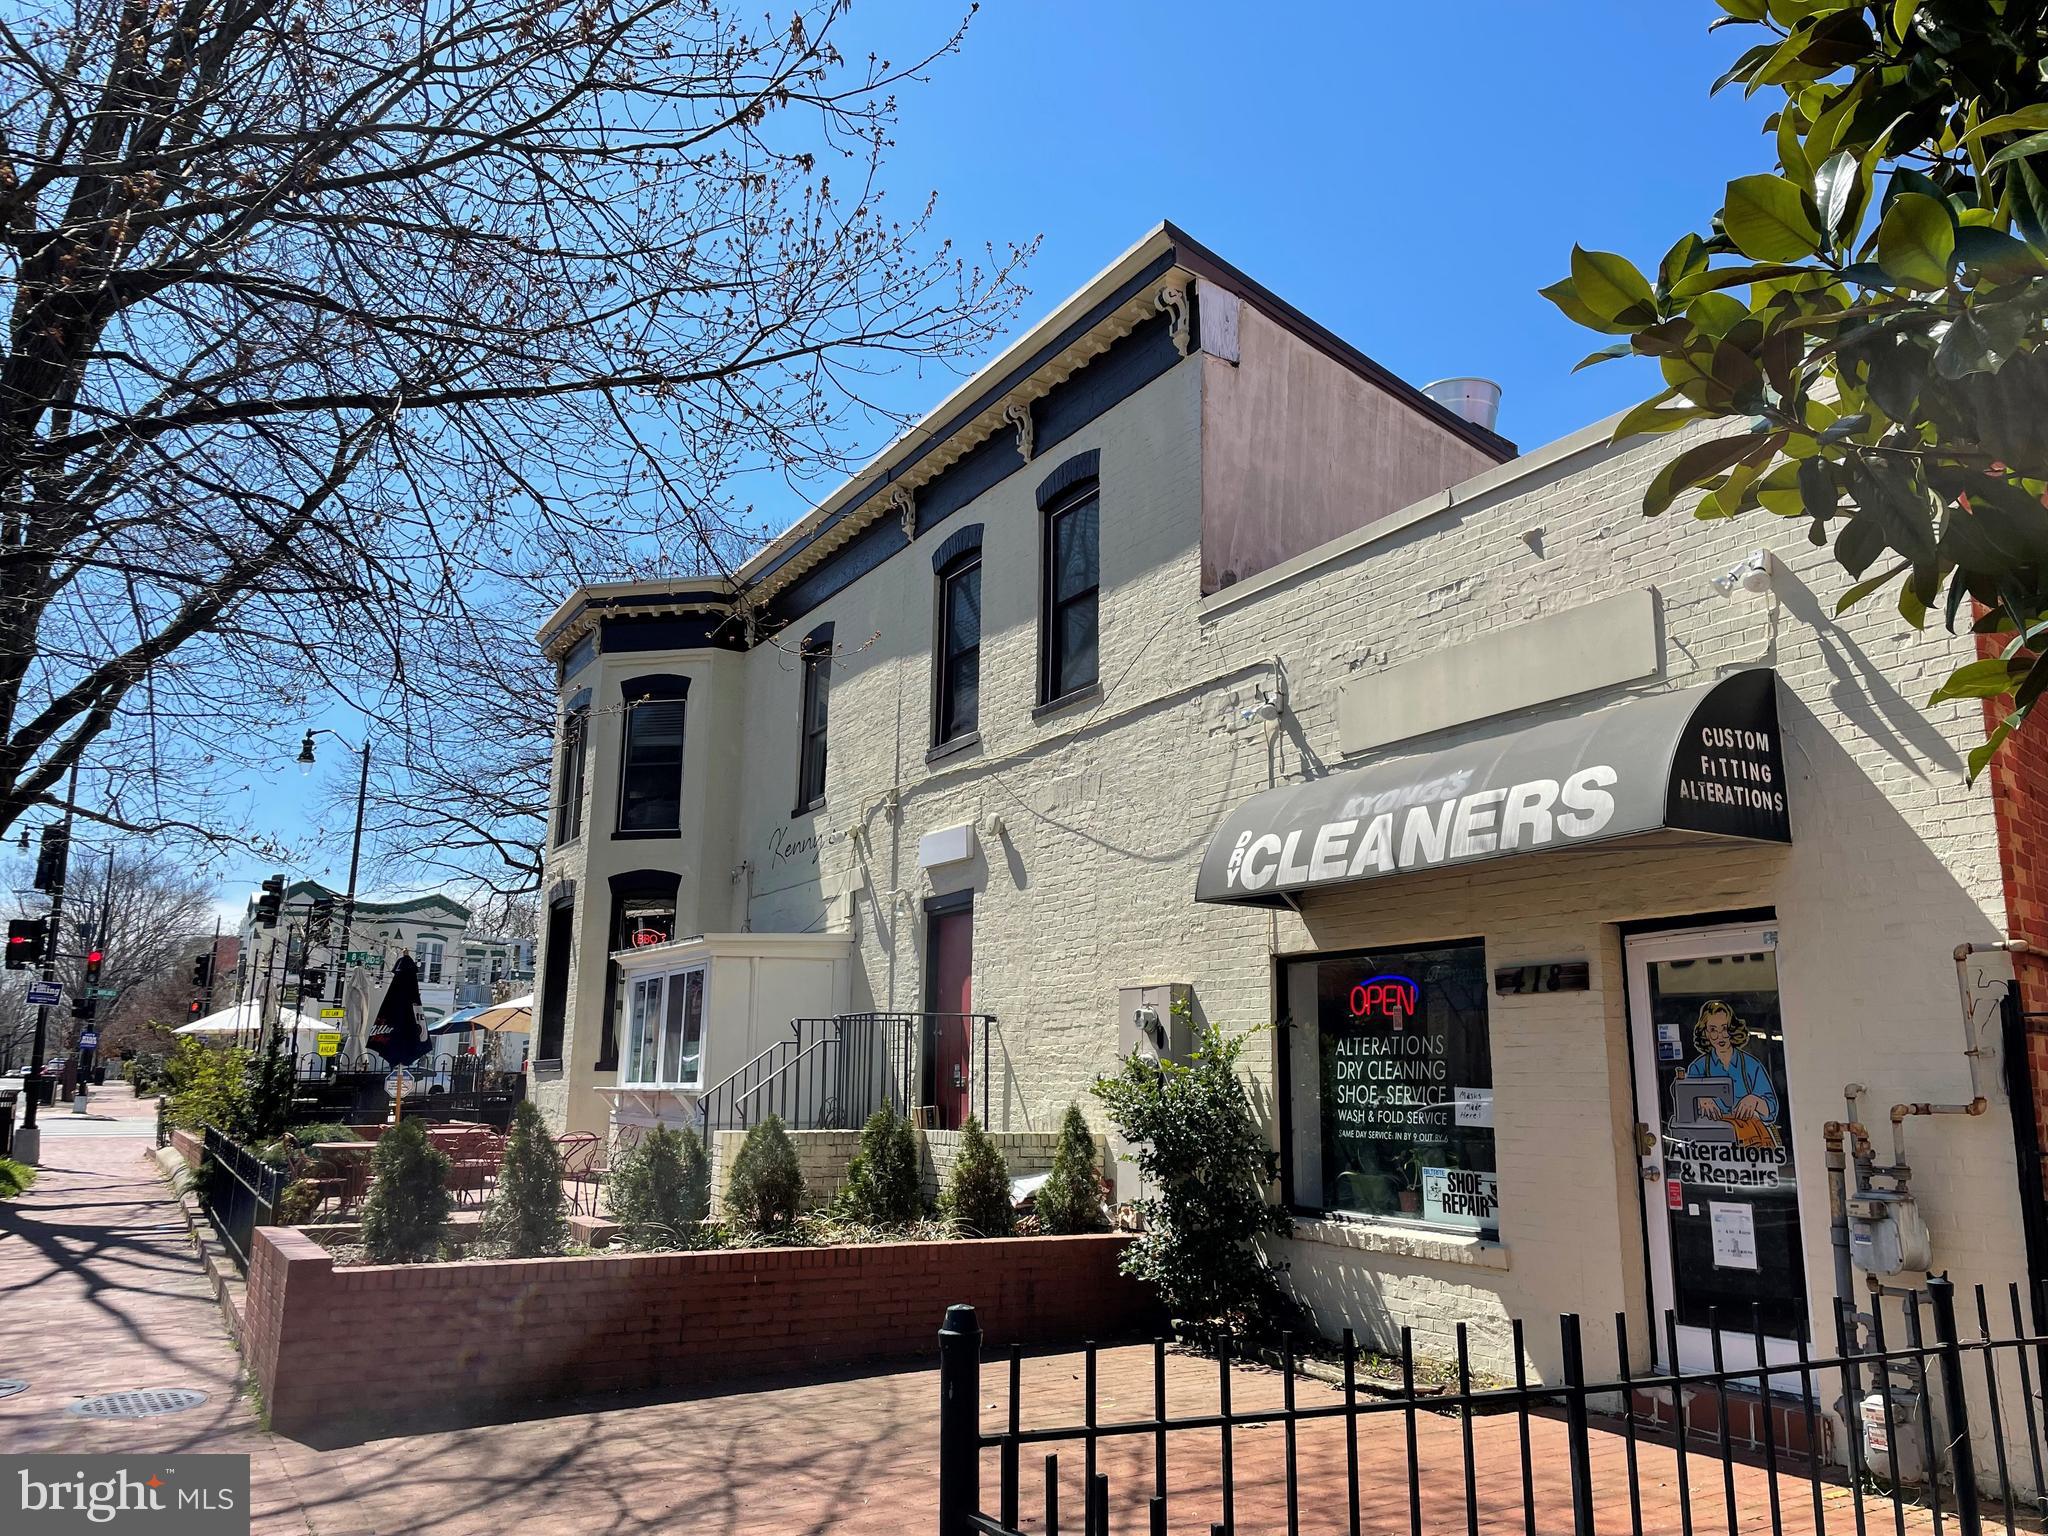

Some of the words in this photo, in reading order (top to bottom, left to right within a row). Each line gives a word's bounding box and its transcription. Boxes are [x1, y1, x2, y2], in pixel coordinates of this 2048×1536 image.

[1702, 727, 1769, 752] CUSTOM
[1701, 755, 1772, 783] FITTING
[1680, 779, 1783, 812] ALTERATIONS
[1227, 830, 1253, 888] DRY
[1240, 765, 1618, 890] CLEANERS
[1350, 985, 1415, 1016] OPEN
[320, 1044, 335, 1053] AHEAD
[1335, 1034, 1444, 1055] ALTERATIONS
[1337, 1060, 1364, 1080] DRY
[1367, 1060, 1446, 1080] CLEANING
[1337, 1085, 1378, 1105] SHOE
[1386, 1085, 1447, 1105] SERVICE
[1338, 1109, 1365, 1122] WASH
[1368, 1110, 1375, 1123] &
[1377, 1110, 1404, 1123] FOLD
[1406, 1112, 1448, 1126] SERVICE
[1338, 1129, 1354, 1139] SAME
[1355, 1130, 1368, 1139] DAY
[1395, 1131, 1402, 1141] IN
[1403, 1132, 1412, 1141] BY
[1413, 1132, 1418, 1142] 9
[1419, 1132, 1433, 1143] OUT
[1435, 1133, 1443, 1143] BY
[1670, 1138, 1786, 1165] Alterations
[1447, 1171, 1483, 1196] SHOE
[1681, 1161, 1697, 1183] &
[1699, 1163, 1778, 1191] Repairs
[1442, 1193, 1490, 1218] REPAIR
